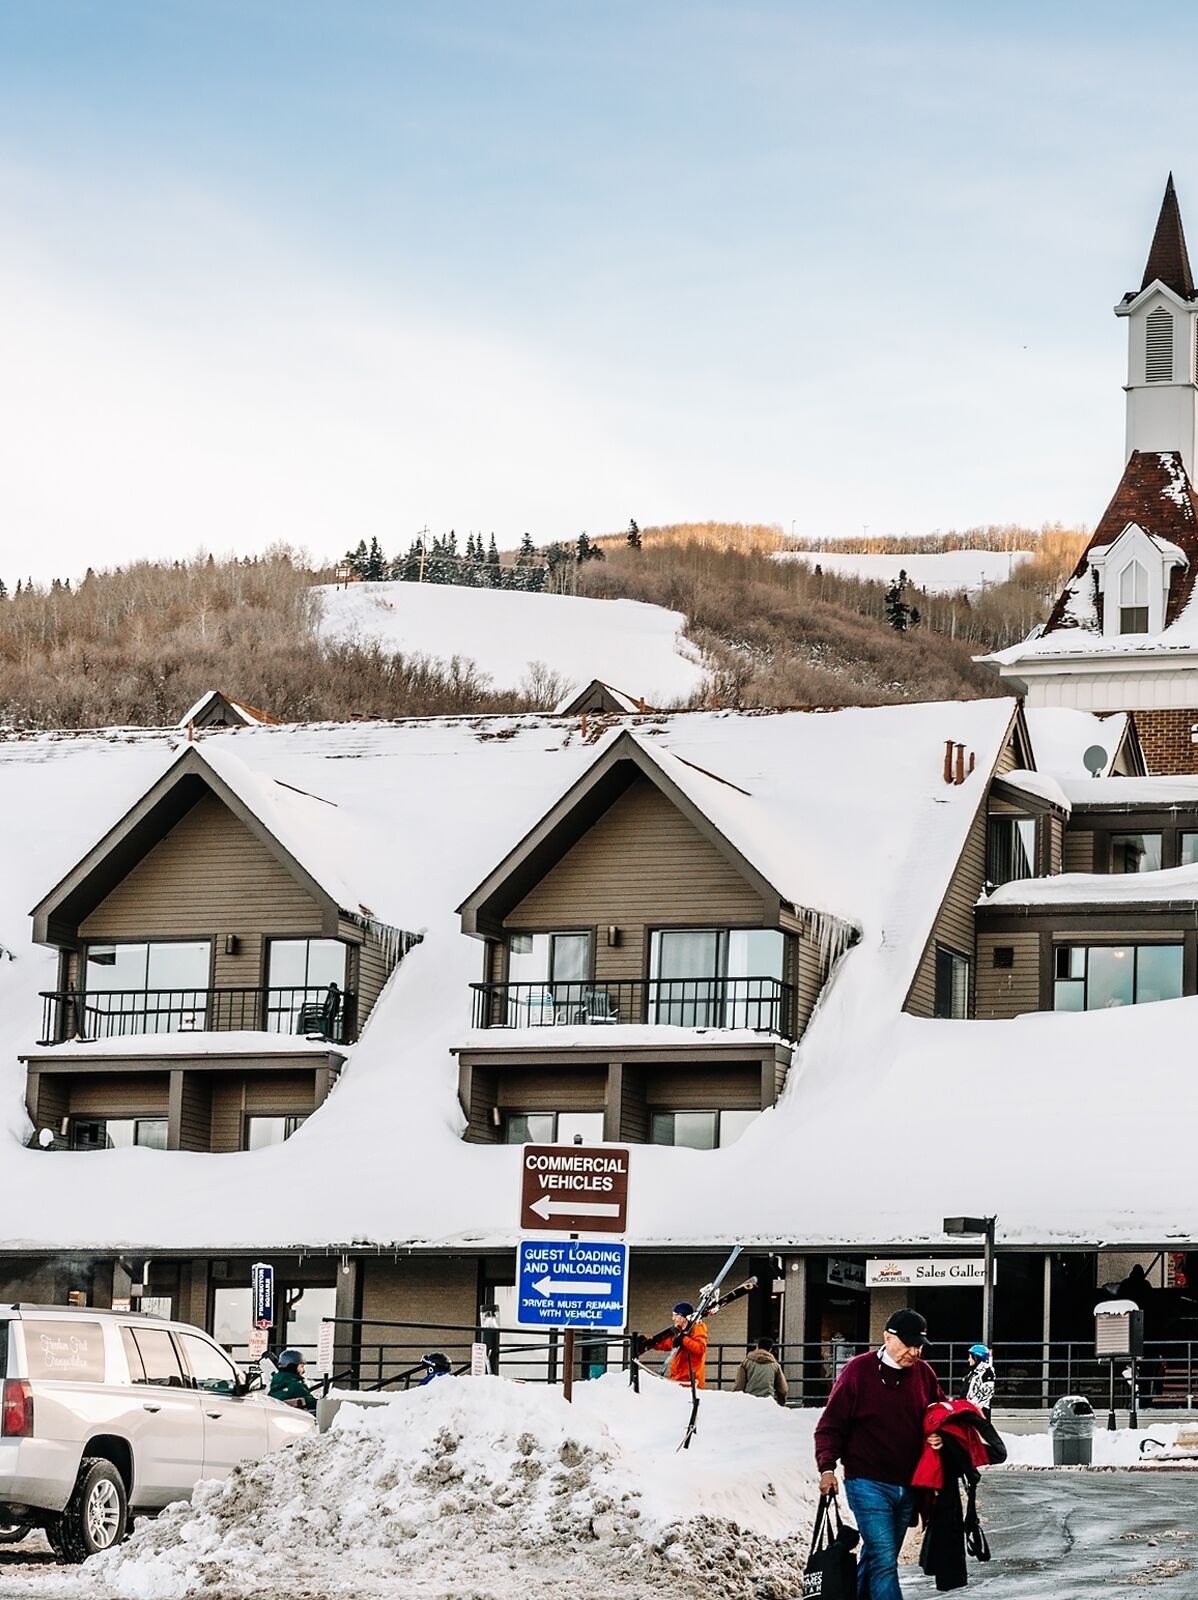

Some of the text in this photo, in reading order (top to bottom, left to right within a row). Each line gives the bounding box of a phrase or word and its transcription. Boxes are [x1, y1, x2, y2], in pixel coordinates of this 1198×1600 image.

[525, 1155, 627, 1173] COMMERCIAL
[538, 1174, 614, 1192] VEHICLES
[525, 1249, 621, 1262] GUEST LOADING
[524, 1263, 621, 1276] AND UNLOADING
[916, 1263, 988, 1278] Sales Galler
[521, 1299, 620, 1310] DRIVER MUST REMAIN
[539, 1309, 603, 1319] WITH VEHICLE
